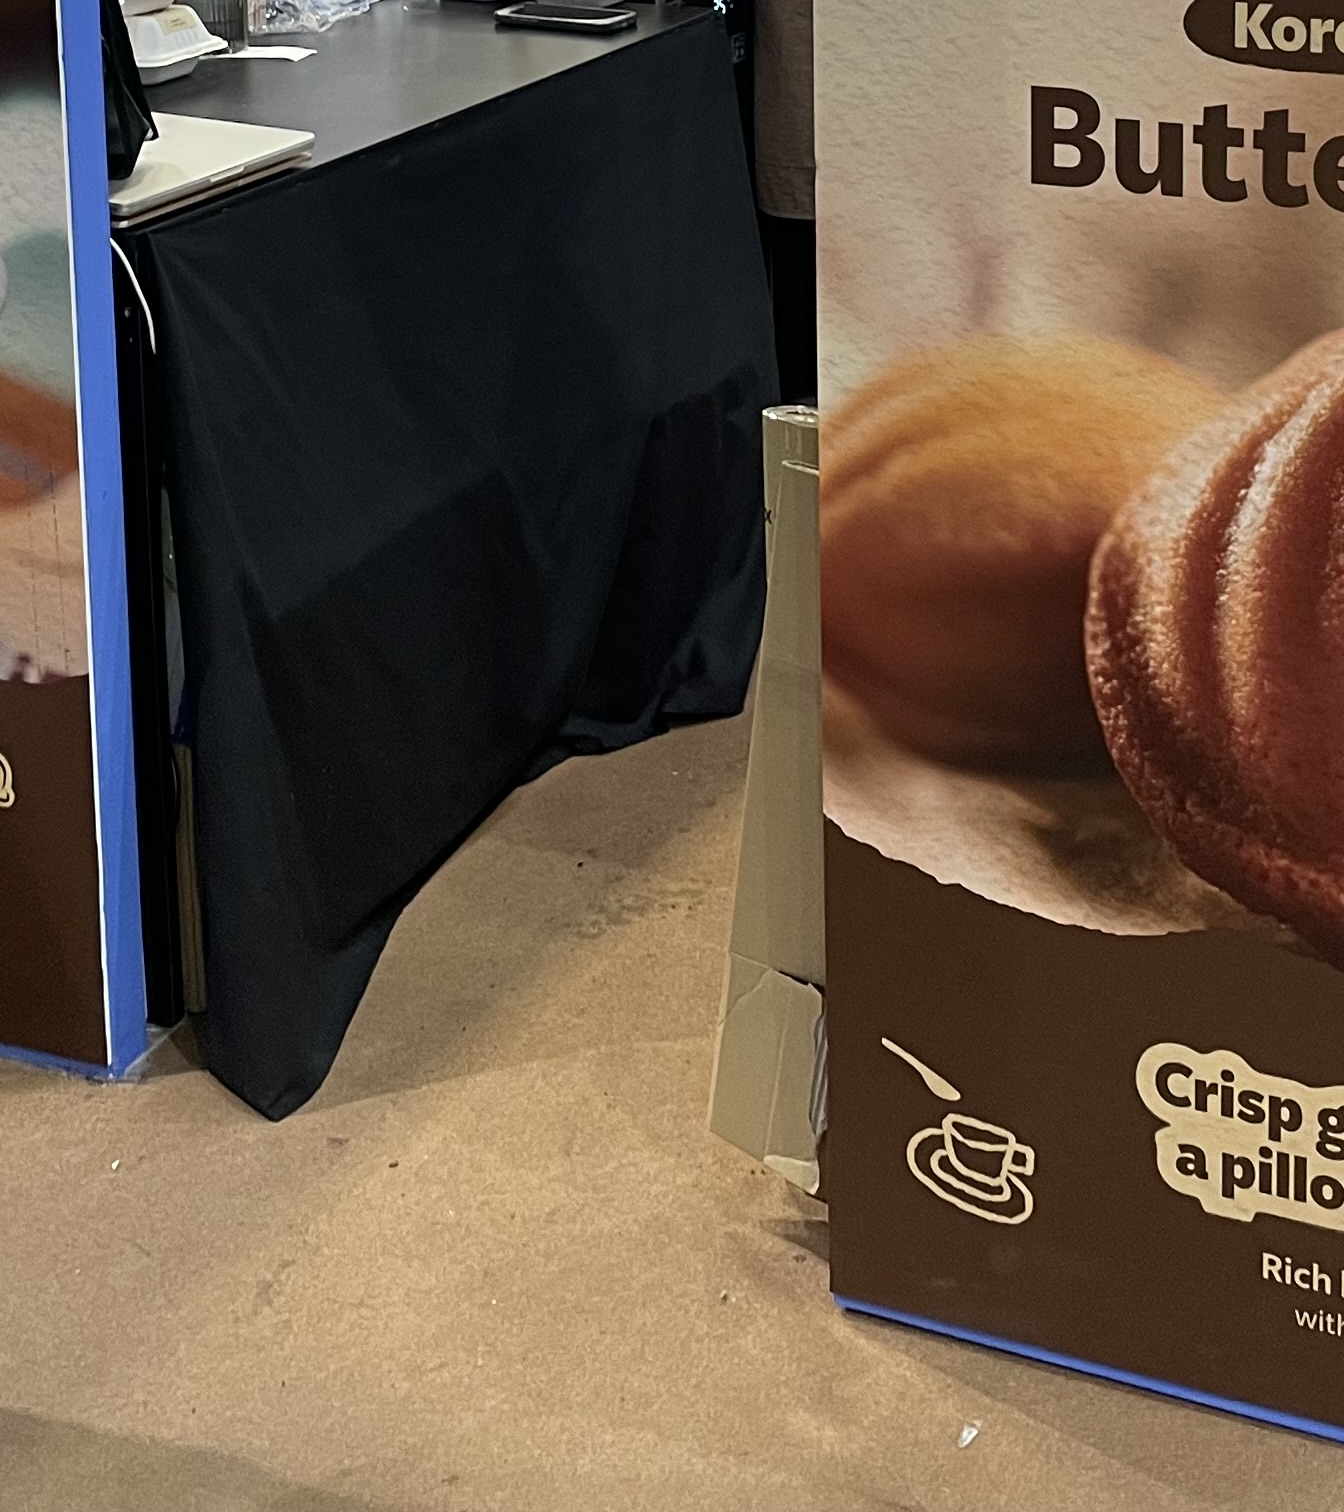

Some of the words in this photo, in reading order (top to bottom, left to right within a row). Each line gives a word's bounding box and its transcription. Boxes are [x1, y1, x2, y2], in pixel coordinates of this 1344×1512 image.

[1152, 1061, 1303, 1140] Crisp
[1174, 1140, 1209, 1181] a
[1260, 1254, 1331, 1296] Rich
